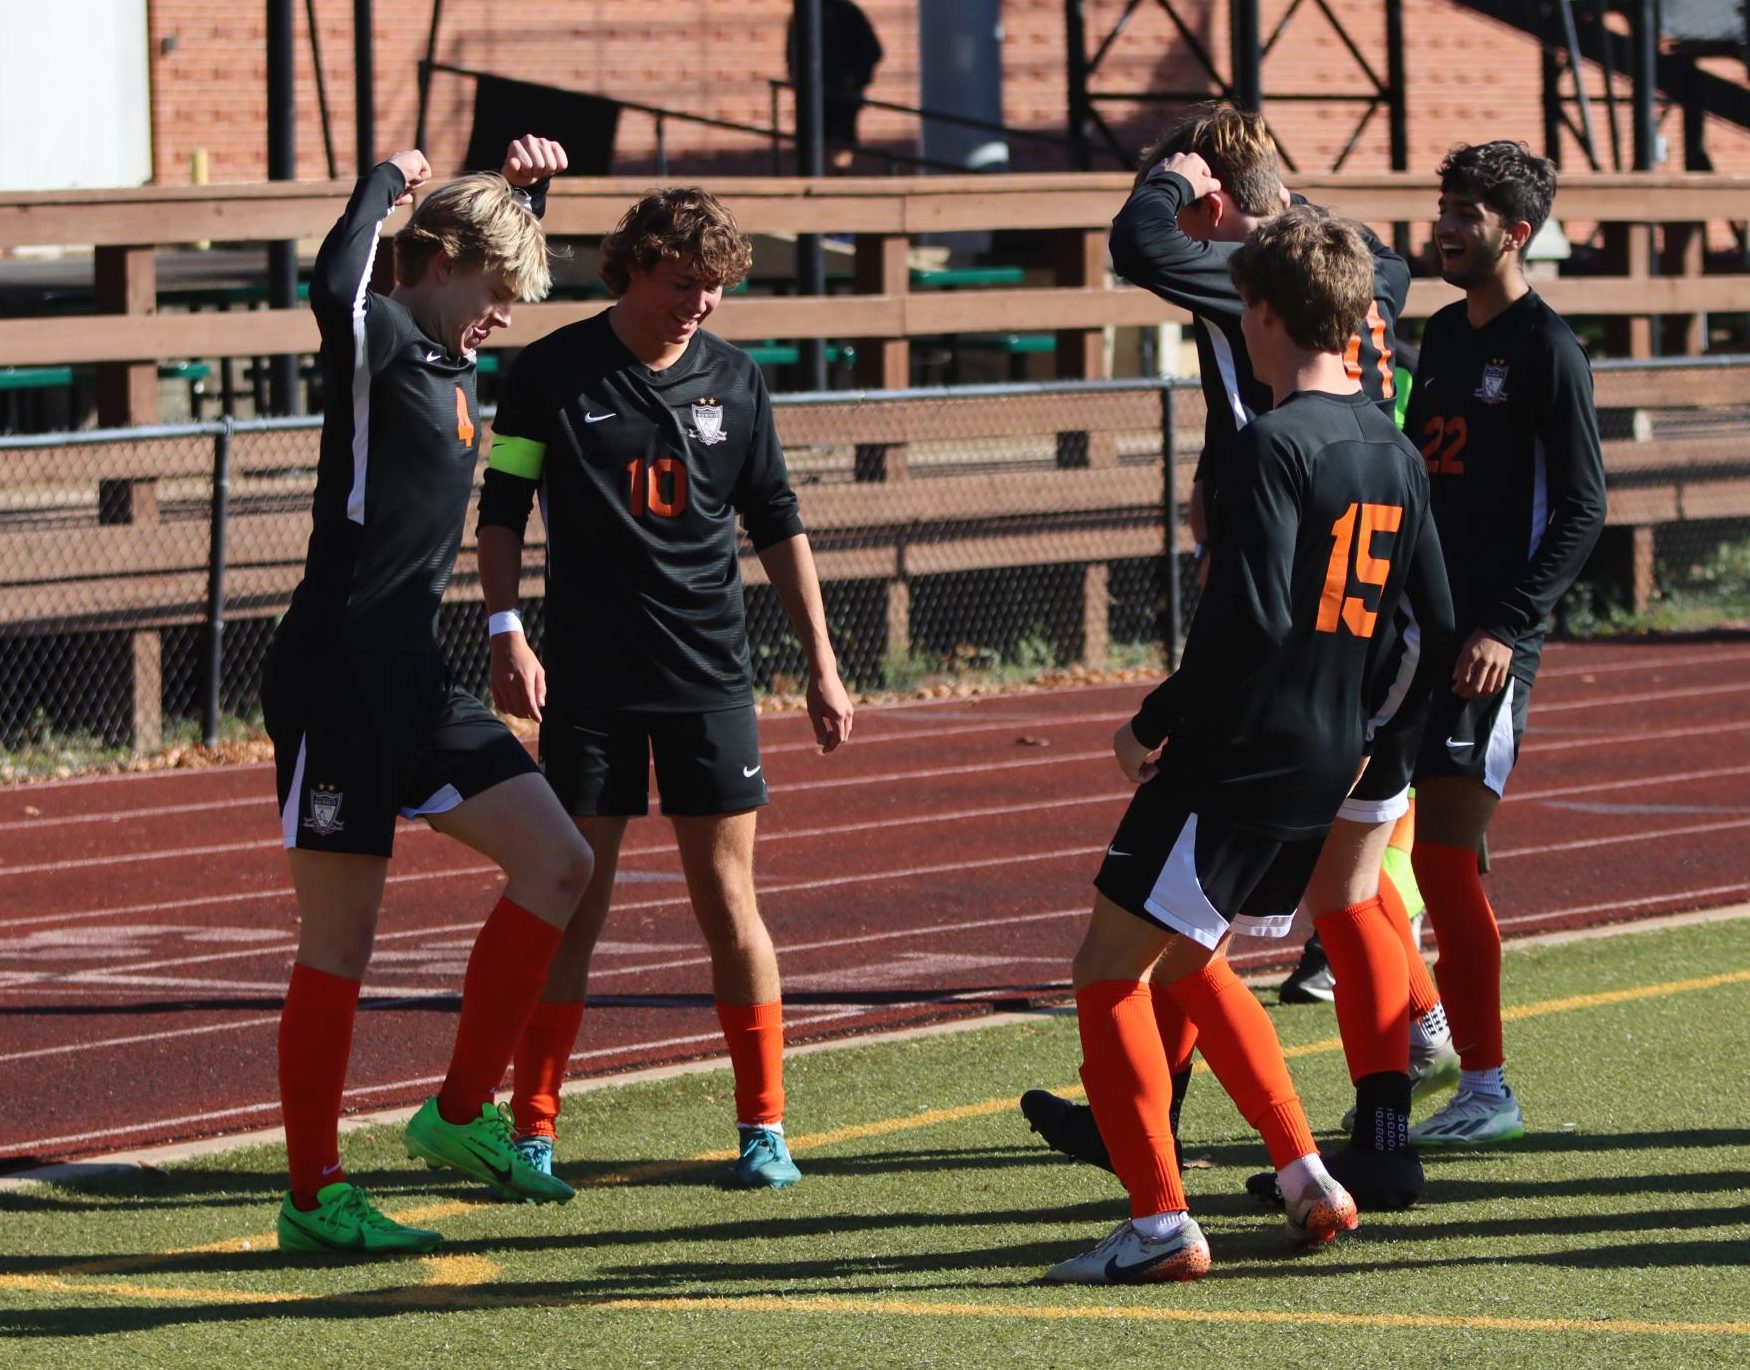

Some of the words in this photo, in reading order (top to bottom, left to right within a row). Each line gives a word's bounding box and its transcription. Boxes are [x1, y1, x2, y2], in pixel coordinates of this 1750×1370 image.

[455, 386, 475, 448] 4
[1421, 415, 1468, 474] 22
[626, 457, 689, 518] 10
[1315, 502, 1403, 638] 15
